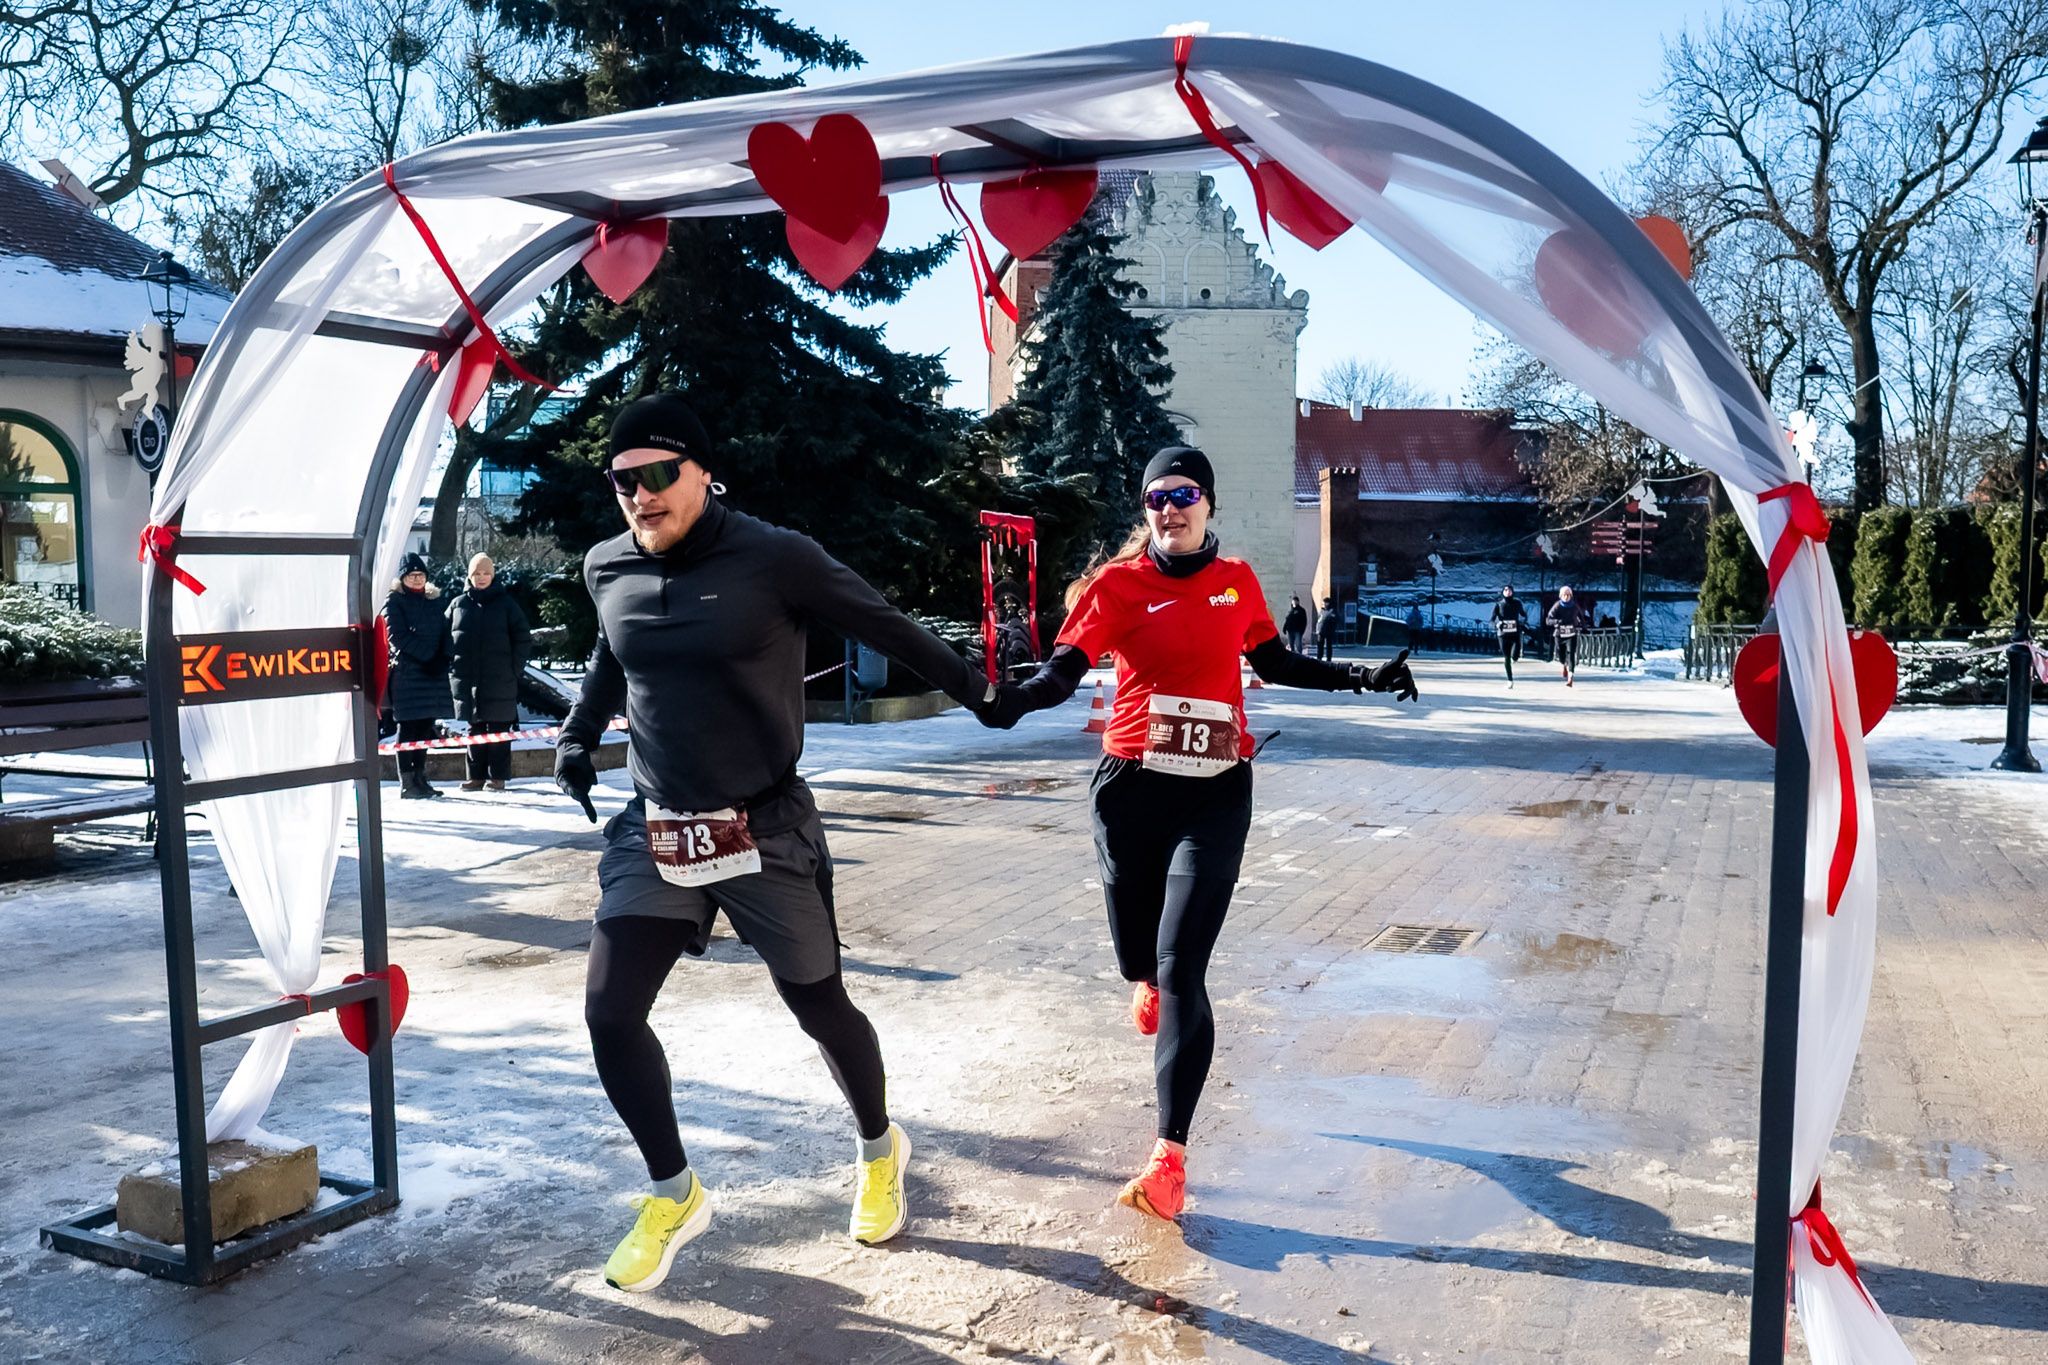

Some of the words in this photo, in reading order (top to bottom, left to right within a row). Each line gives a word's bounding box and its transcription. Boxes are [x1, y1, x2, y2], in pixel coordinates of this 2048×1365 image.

[1208, 592, 1236, 607] polo
[1181, 722, 1211, 753] 13
[682, 824, 716, 859] 13
